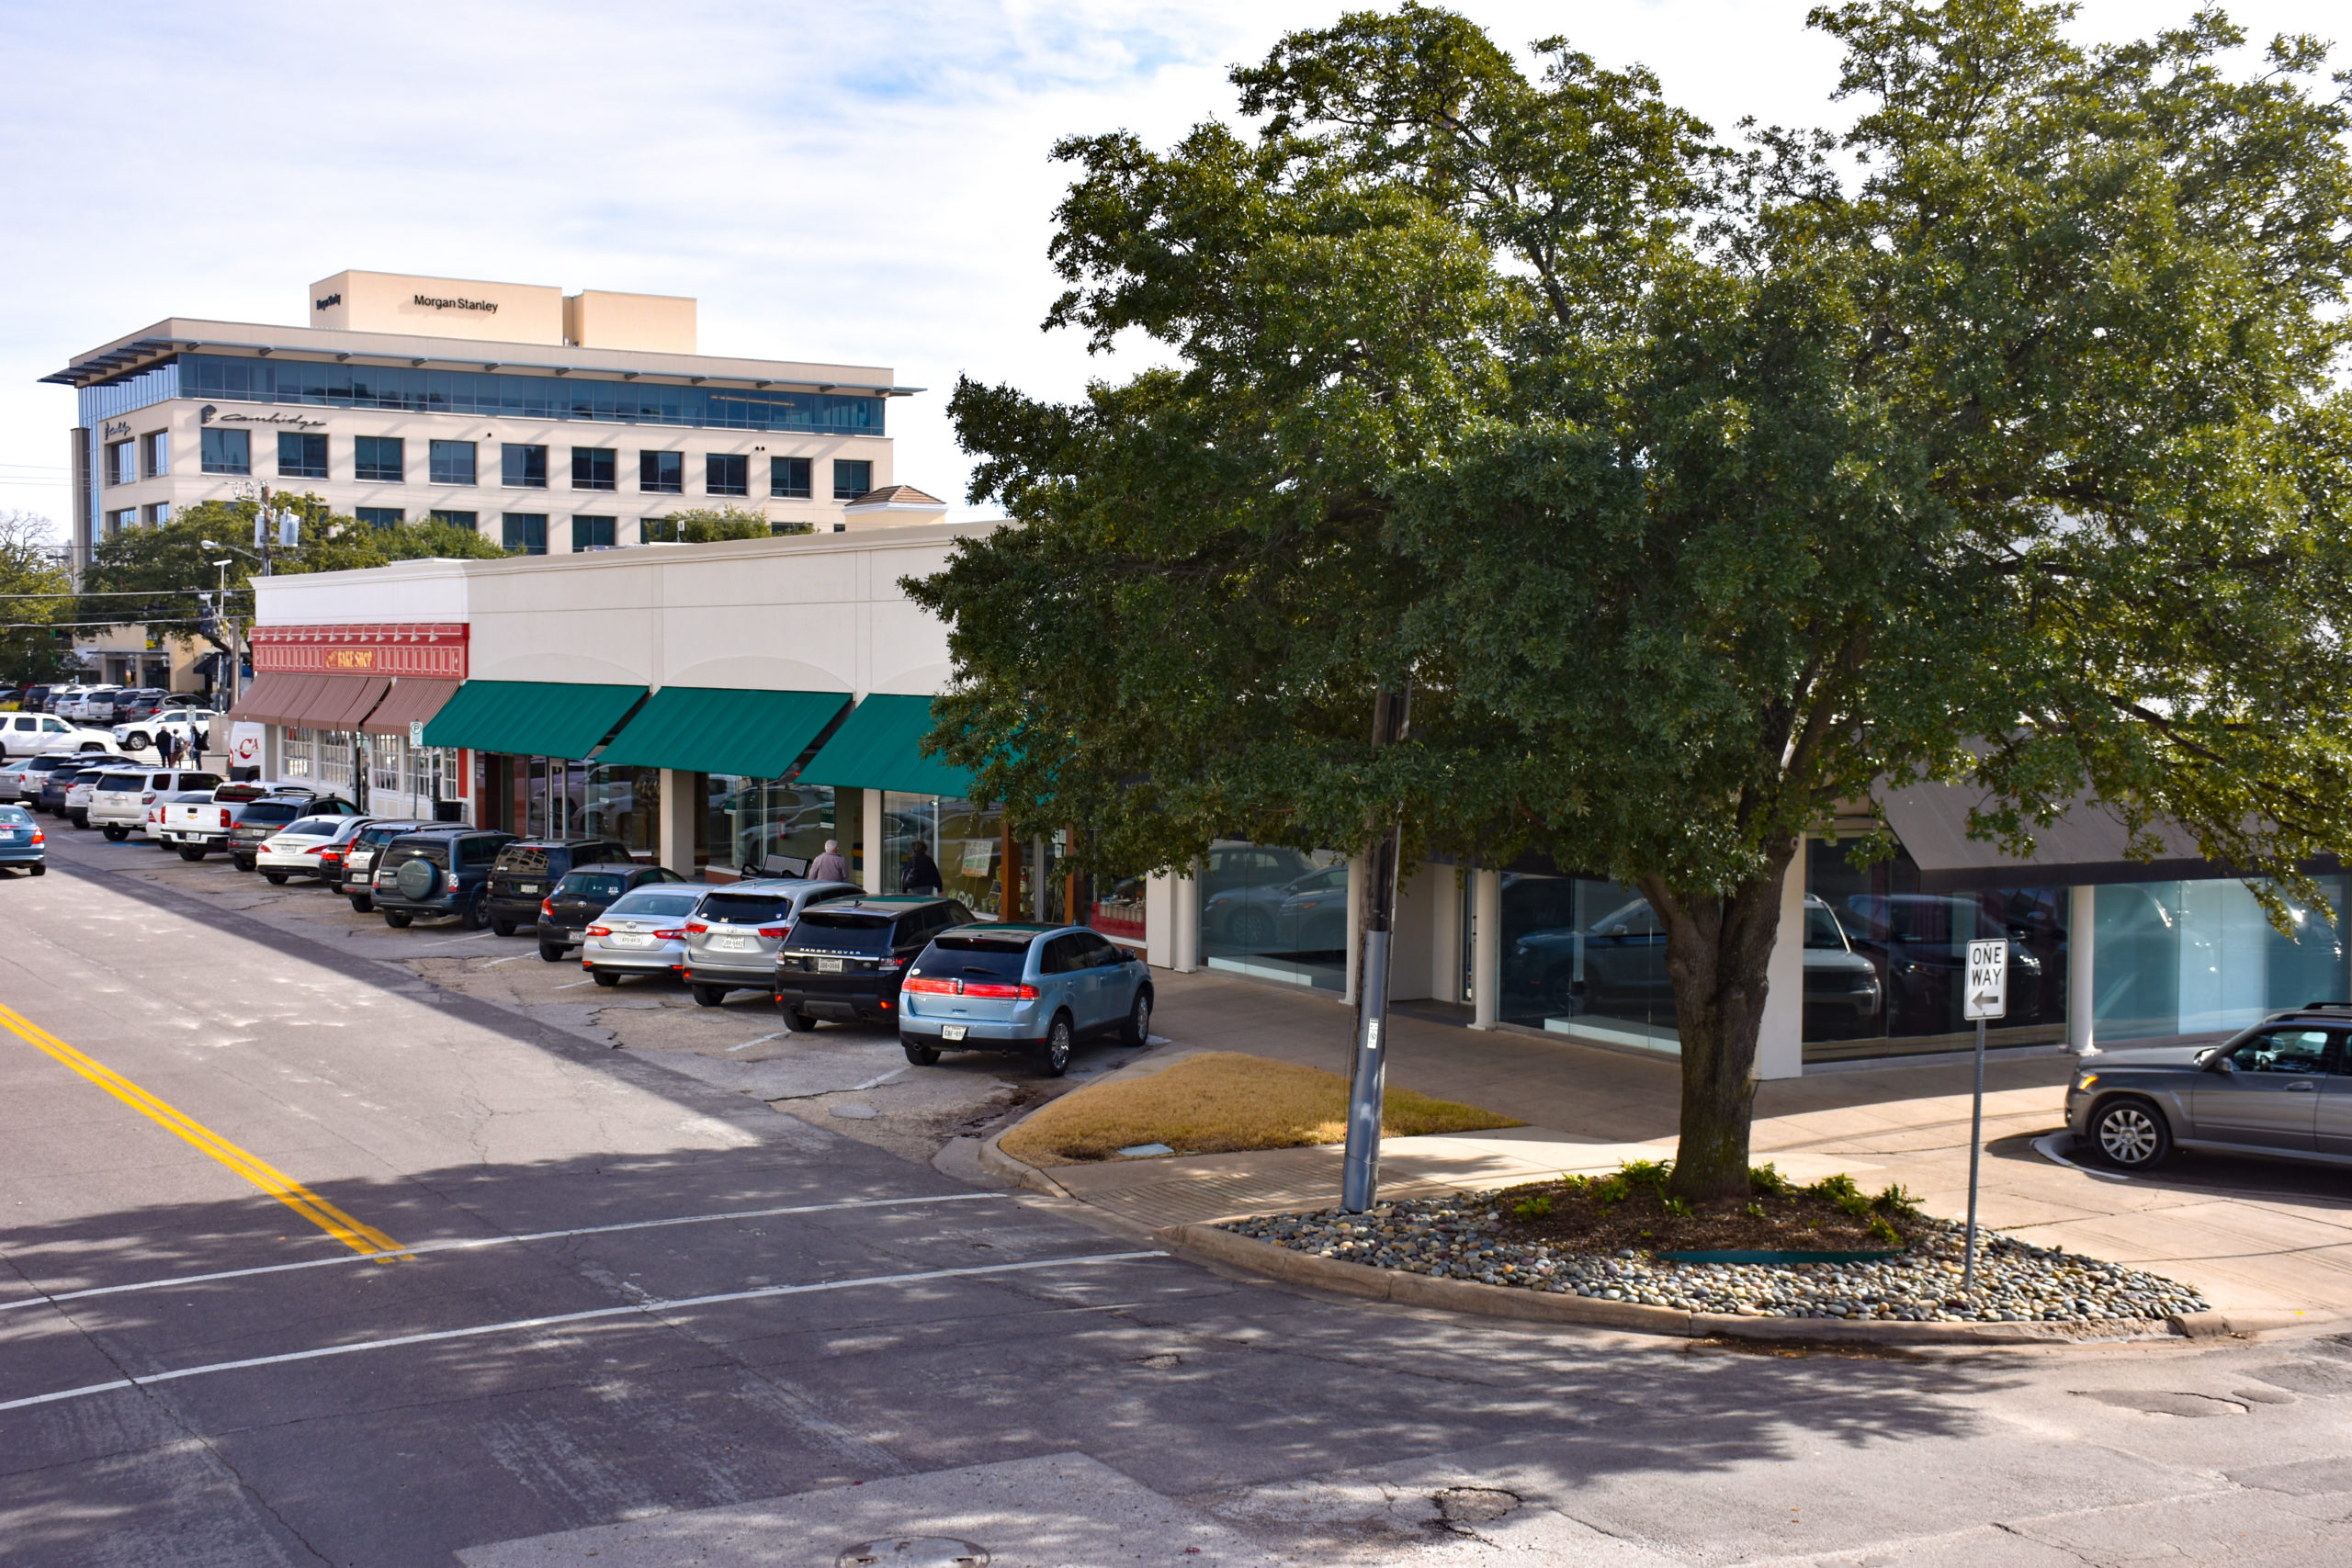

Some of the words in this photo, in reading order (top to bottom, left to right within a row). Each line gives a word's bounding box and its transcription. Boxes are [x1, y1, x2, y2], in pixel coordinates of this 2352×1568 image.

[414, 294, 456, 310] Morgan
[458, 298, 498, 314] Stanley
[1973, 946, 2002, 965] ONE
[1972, 967, 2002, 987] WAY
